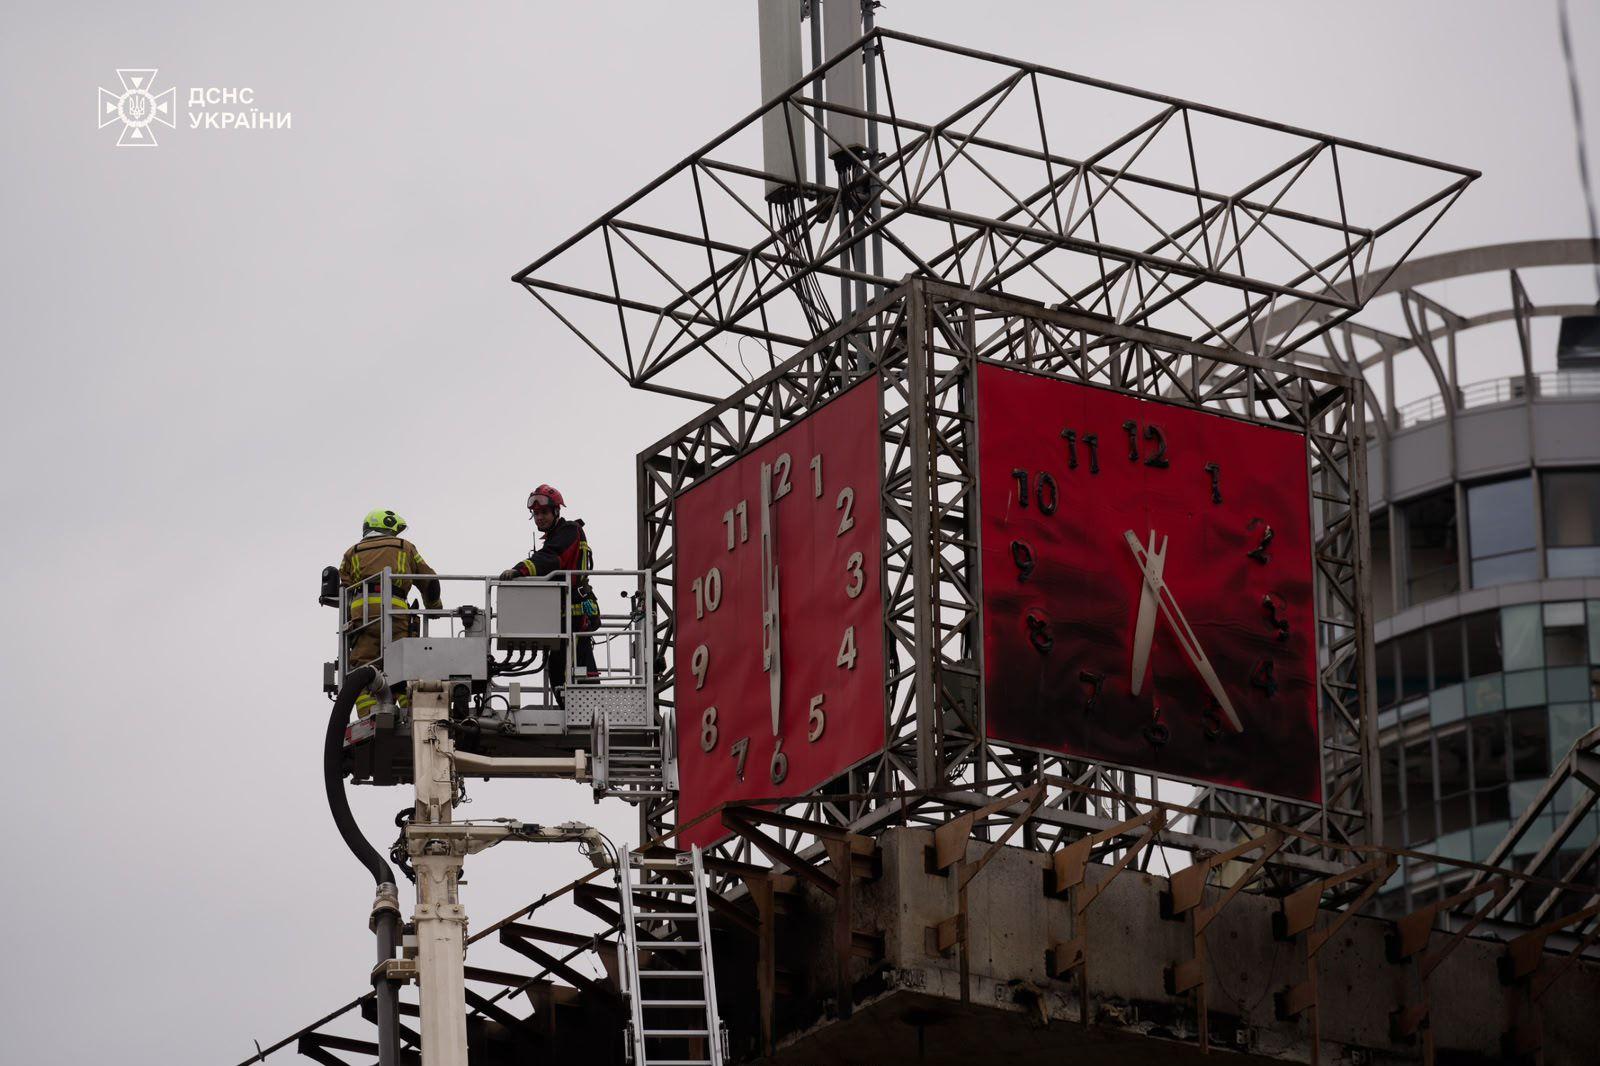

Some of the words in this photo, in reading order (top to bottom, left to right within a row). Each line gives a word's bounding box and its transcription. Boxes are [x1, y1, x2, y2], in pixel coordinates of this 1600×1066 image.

[1061, 428, 1099, 473] 11
[1122, 420, 1169, 467] 12
[810, 454, 822, 497] 1
[1013, 468, 1058, 515] 10
[1205, 463, 1222, 504] 1
[723, 499, 749, 551] 11
[836, 487, 854, 537] 2
[846, 551, 863, 598] 3
[1012, 541, 1036, 581] 9
[691, 568, 721, 619] 10
[837, 626, 857, 669] 4
[1026, 612, 1053, 654] 8
[691, 644, 709, 690] 9
[1080, 671, 1104, 712] 7
[701, 706, 718, 752] 8
[808, 694, 824, 742] 5
[731, 737, 749, 779] 7
[771, 738, 788, 784] 6
